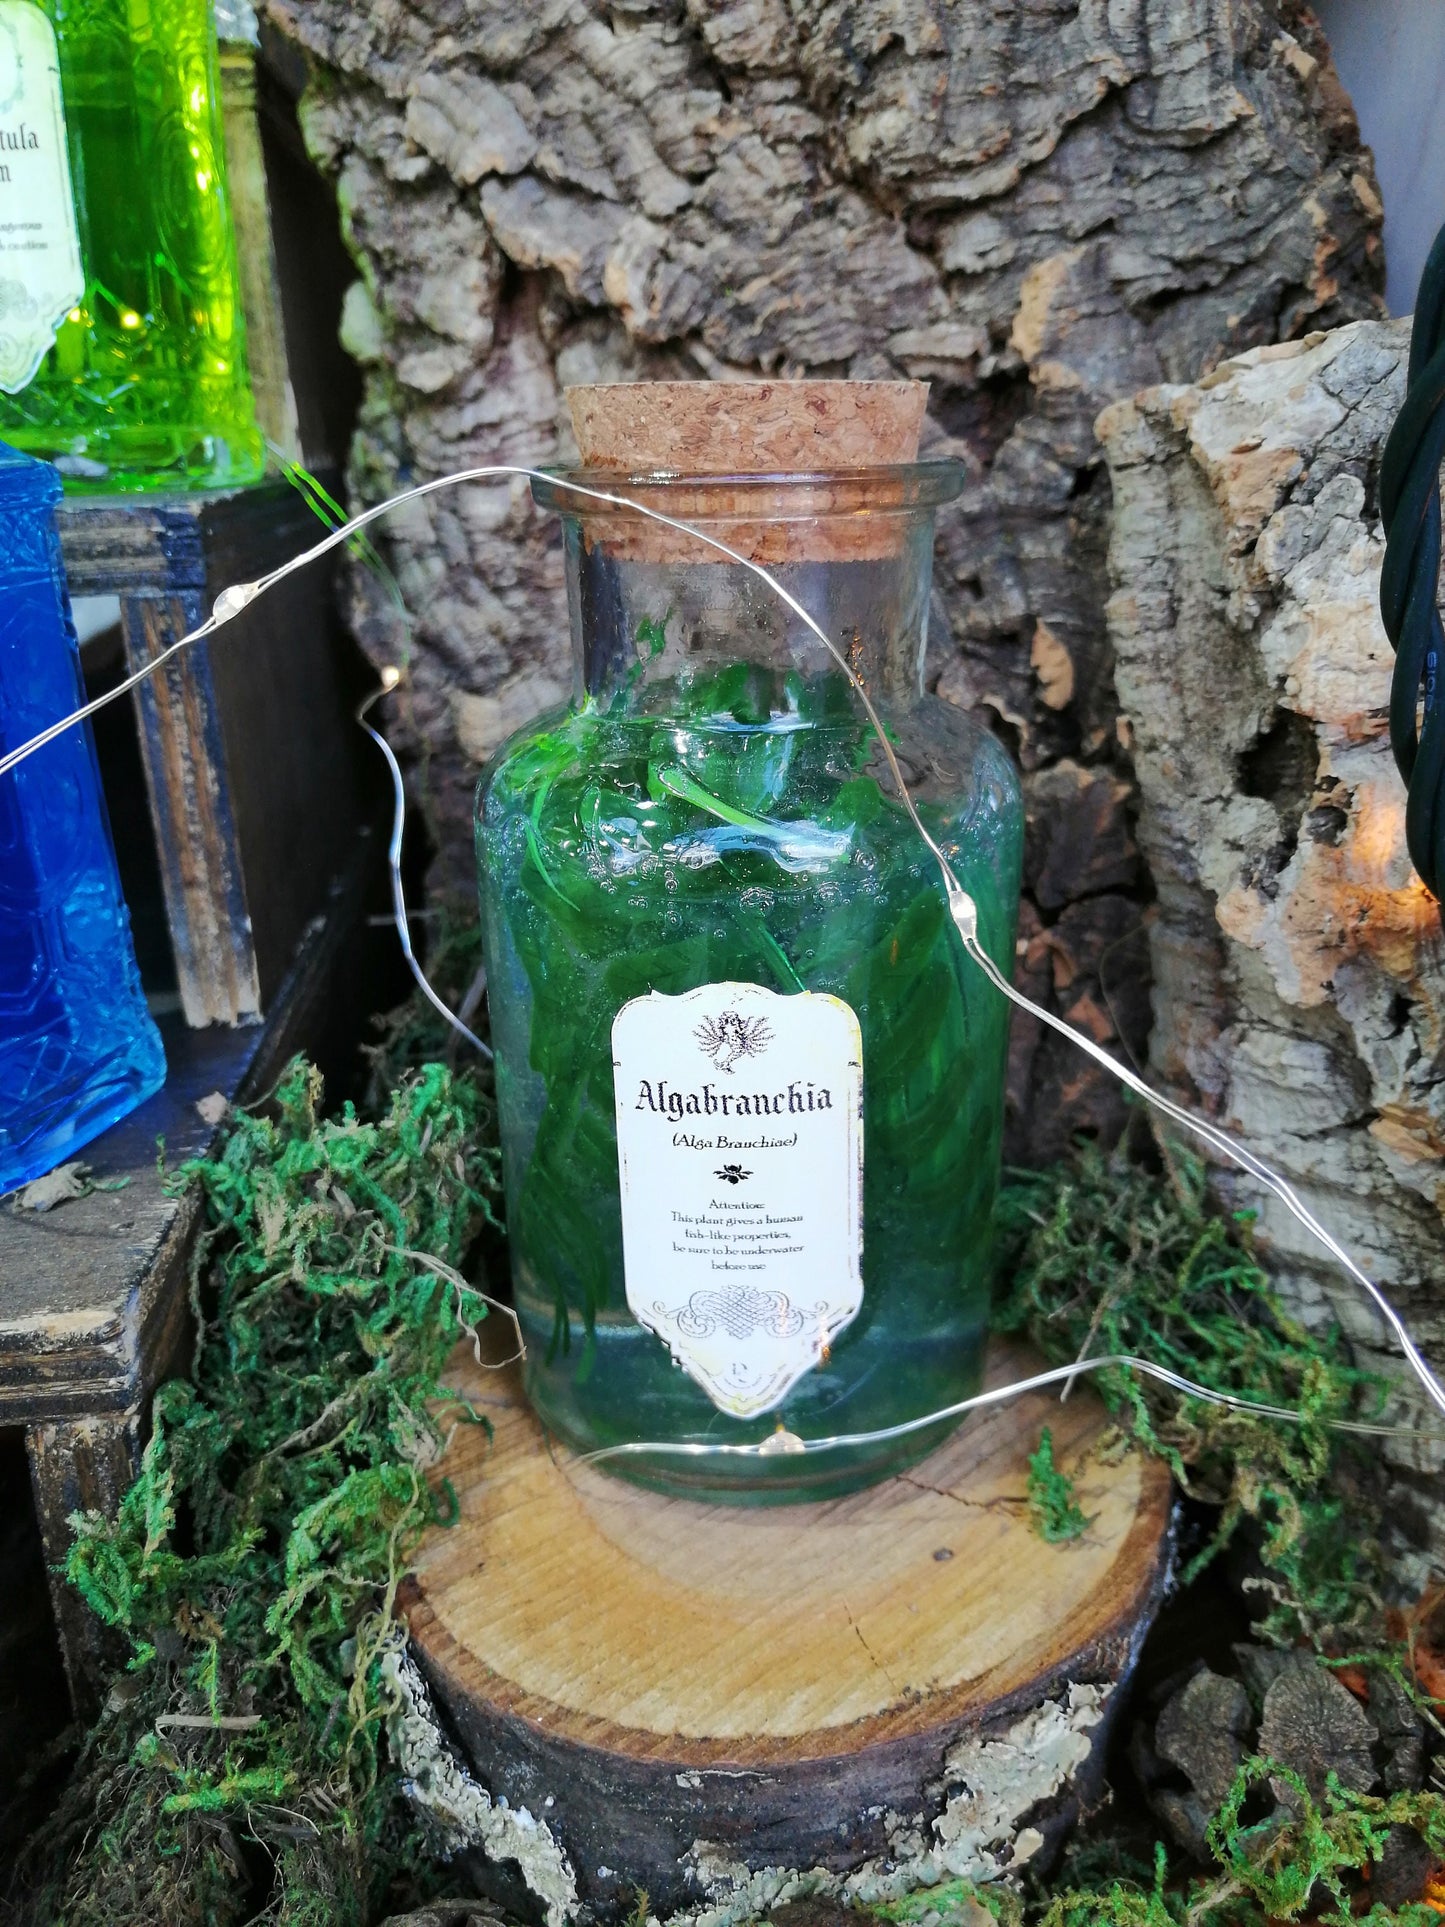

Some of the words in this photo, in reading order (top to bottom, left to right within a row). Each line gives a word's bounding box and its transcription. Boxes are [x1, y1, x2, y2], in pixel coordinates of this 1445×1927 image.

[635, 1080, 833, 1122] Algabranchia
[672, 1132, 713, 1150] (Alga
[671, 1210, 694, 1223] This
[695, 1214, 724, 1225] plant
[725, 1217, 755, 1227] gives
[766, 1214, 804, 1224] human
[685, 1229, 731, 1240] fish-like
[673, 1241, 686, 1252] be
[724, 1245, 739, 1255] be
[741, 1245, 805, 1255] underwater
[711, 1260, 747, 1271] before
[748, 1263, 767, 1271] use
